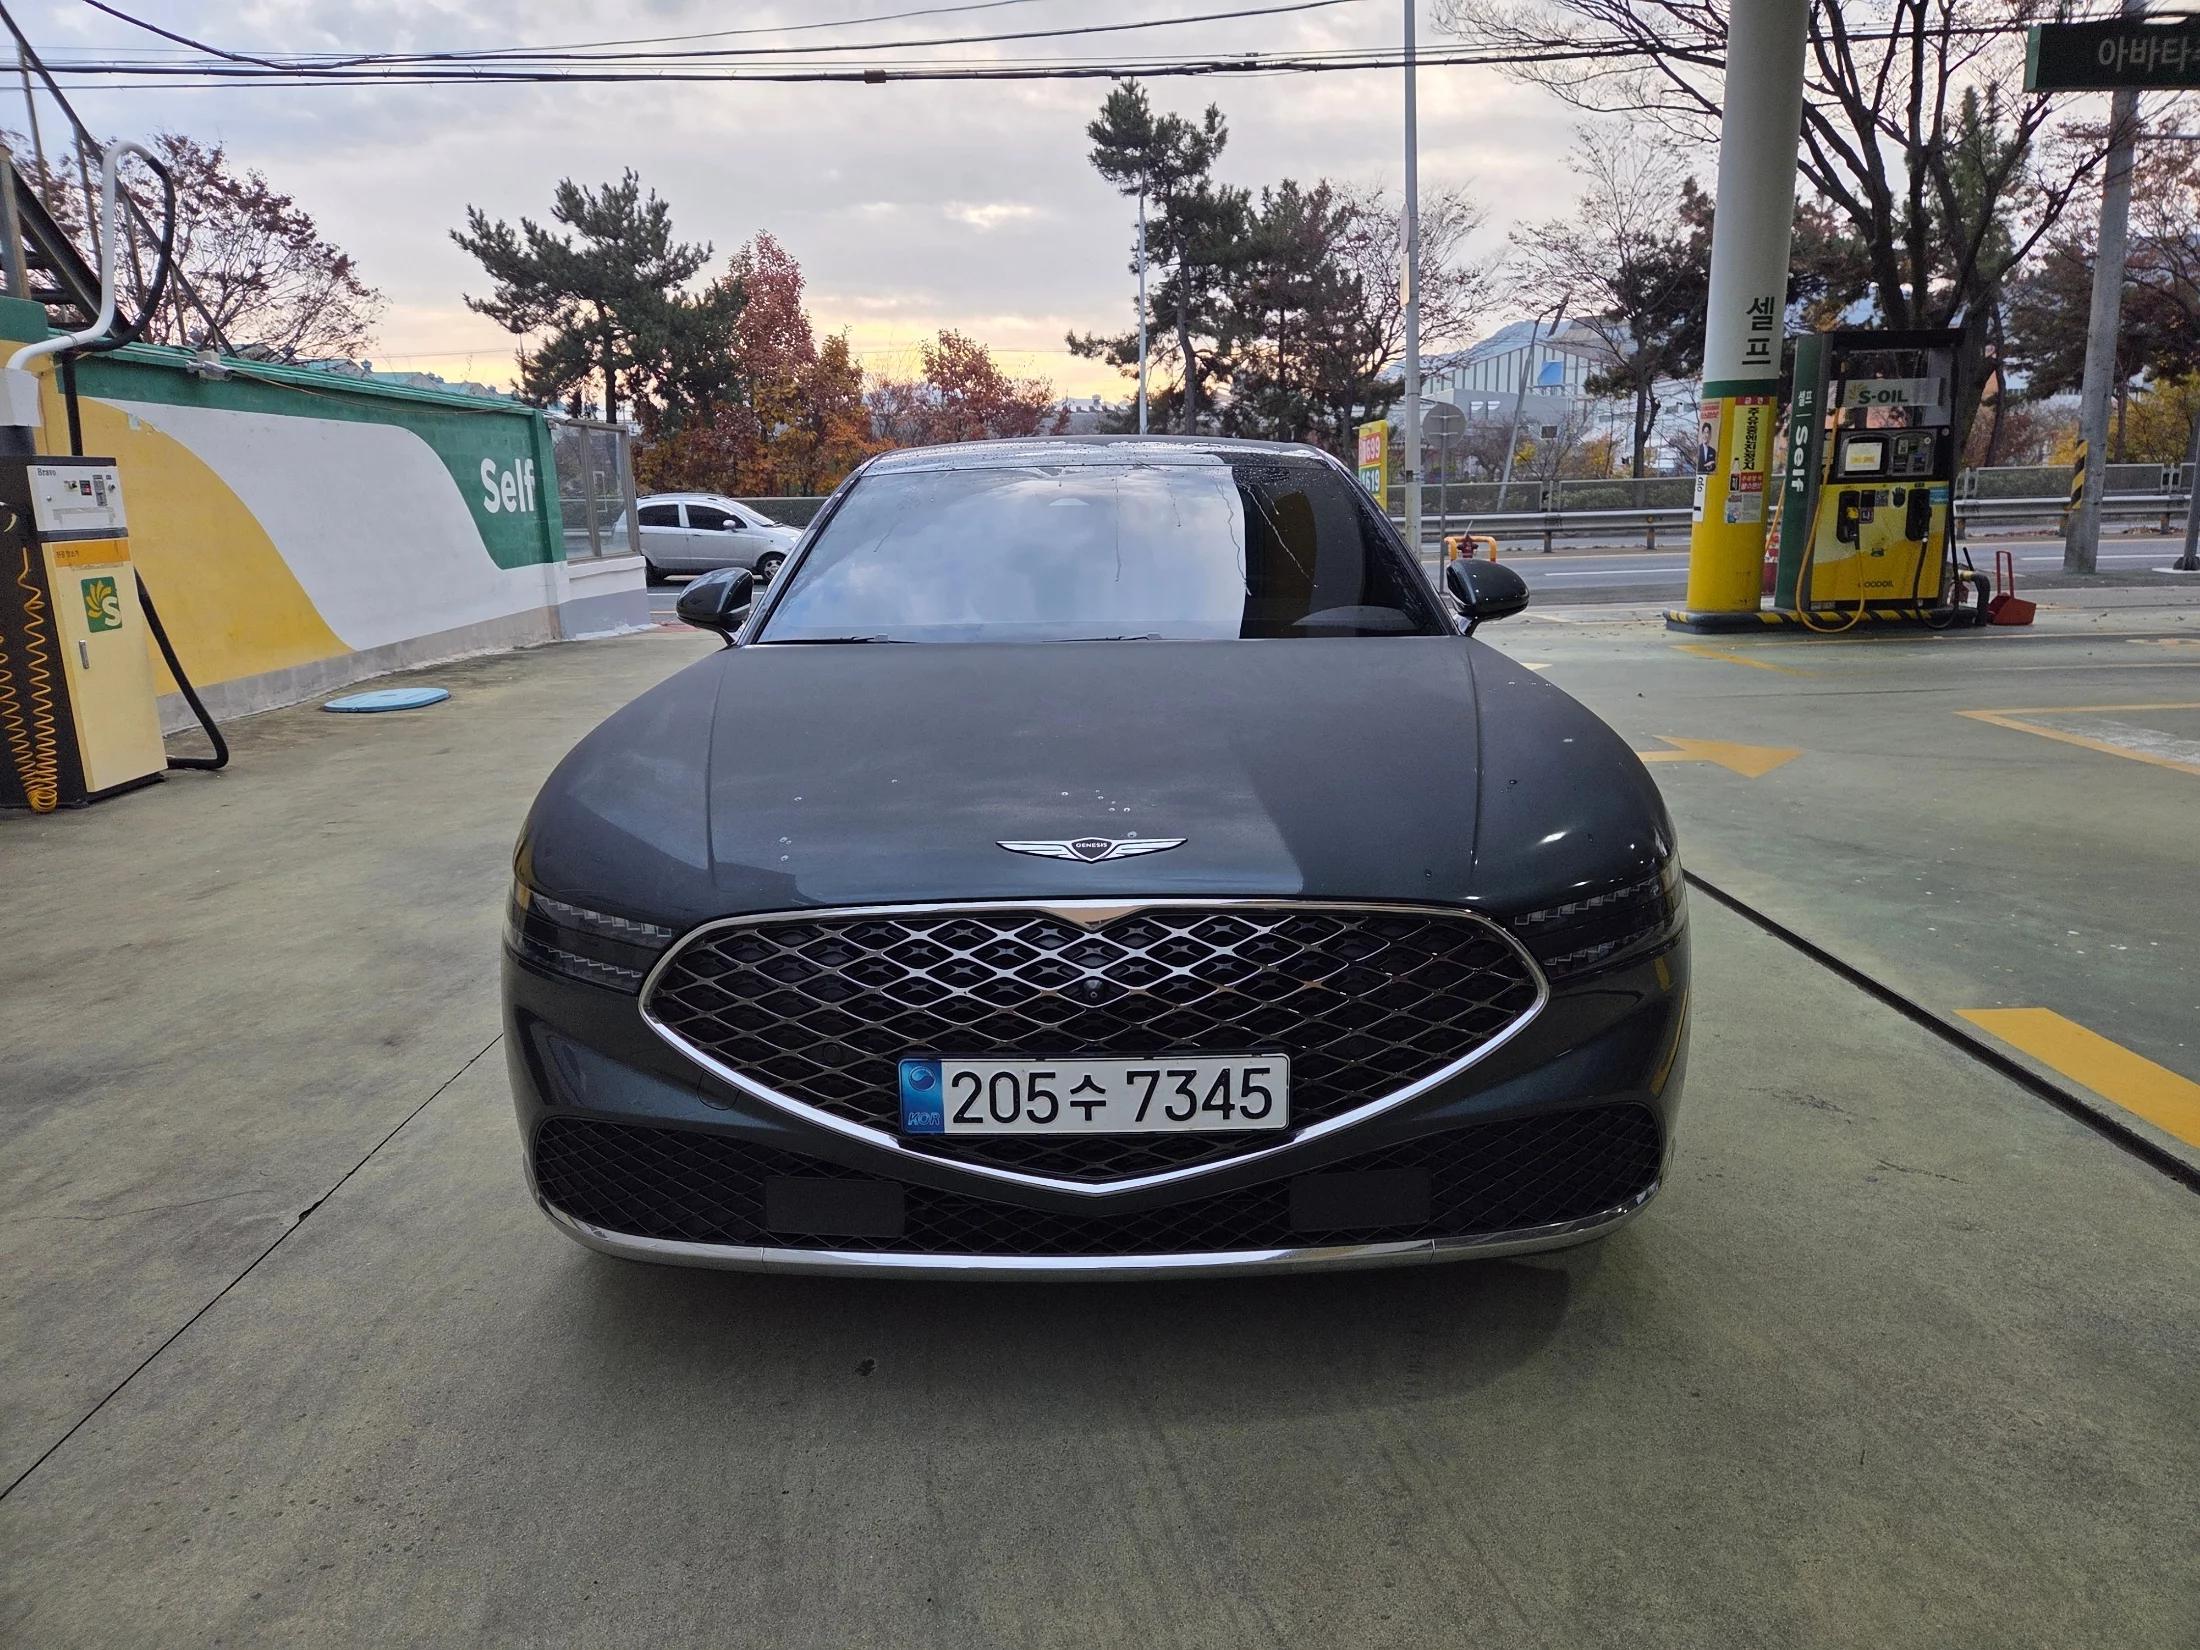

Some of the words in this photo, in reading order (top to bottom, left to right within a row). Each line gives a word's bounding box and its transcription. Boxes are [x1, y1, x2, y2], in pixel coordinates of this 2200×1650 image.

[2100, 36, 2200, 71] 아바타
[1742, 296, 1775, 366] 셀프
[1858, 390, 1909, 405] S-OIL
[37, 468, 57, 477] Bravo
[1791, 425, 1809, 493] Self
[481, 458, 536, 513] Self
[951, 1071, 1107, 1125] 205수
[1127, 1067, 1273, 1123] 7345
[908, 1112, 941, 1126] KOR
